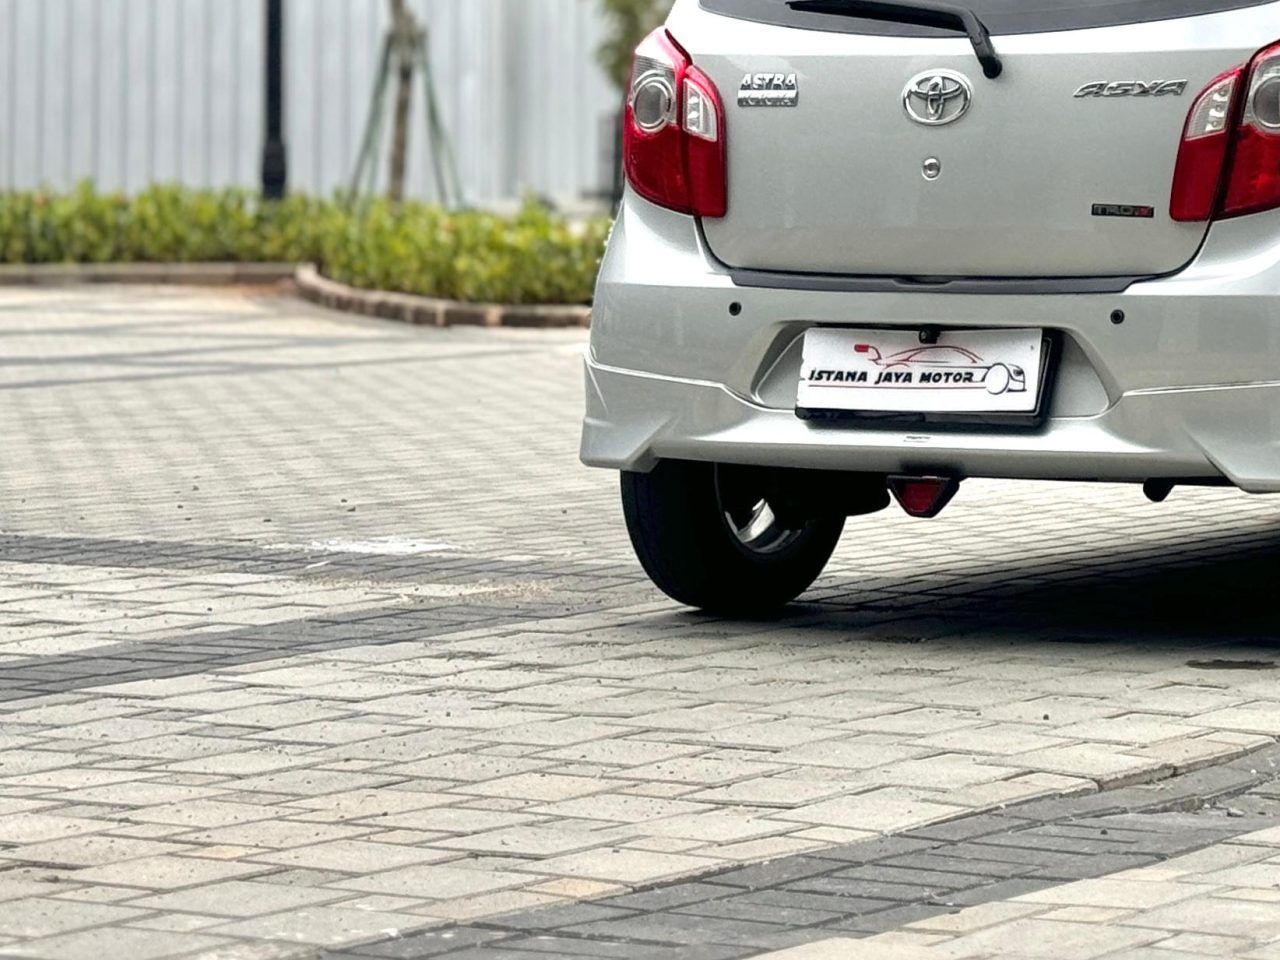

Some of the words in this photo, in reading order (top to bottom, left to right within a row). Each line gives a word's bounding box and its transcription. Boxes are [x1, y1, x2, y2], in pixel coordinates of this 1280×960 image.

[741, 72, 797, 90] ASTRA
[808, 368, 868, 383] ISTANA
[874, 370, 913, 385] JAYA
[919, 371, 974, 384] MOTOR
